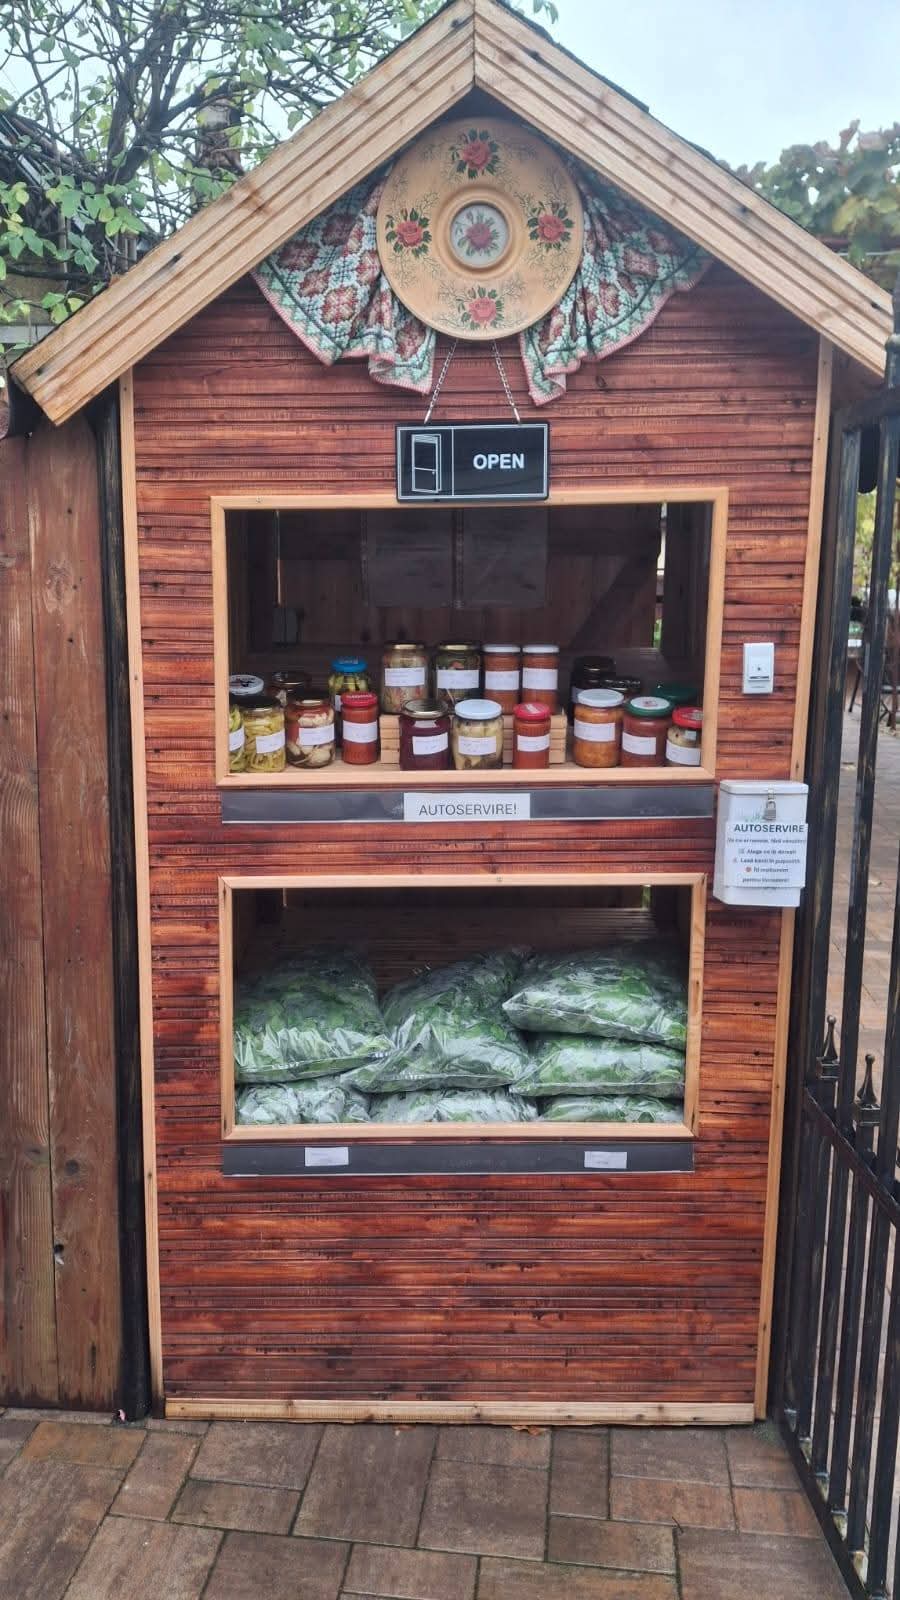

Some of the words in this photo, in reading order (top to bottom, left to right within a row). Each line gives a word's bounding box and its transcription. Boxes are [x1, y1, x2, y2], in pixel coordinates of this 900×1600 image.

[473, 453, 525, 470] OPEN
[418, 803, 518, 816] AUTOSERVIRE!
[734, 824, 805, 833] AUTOSERVIRE
